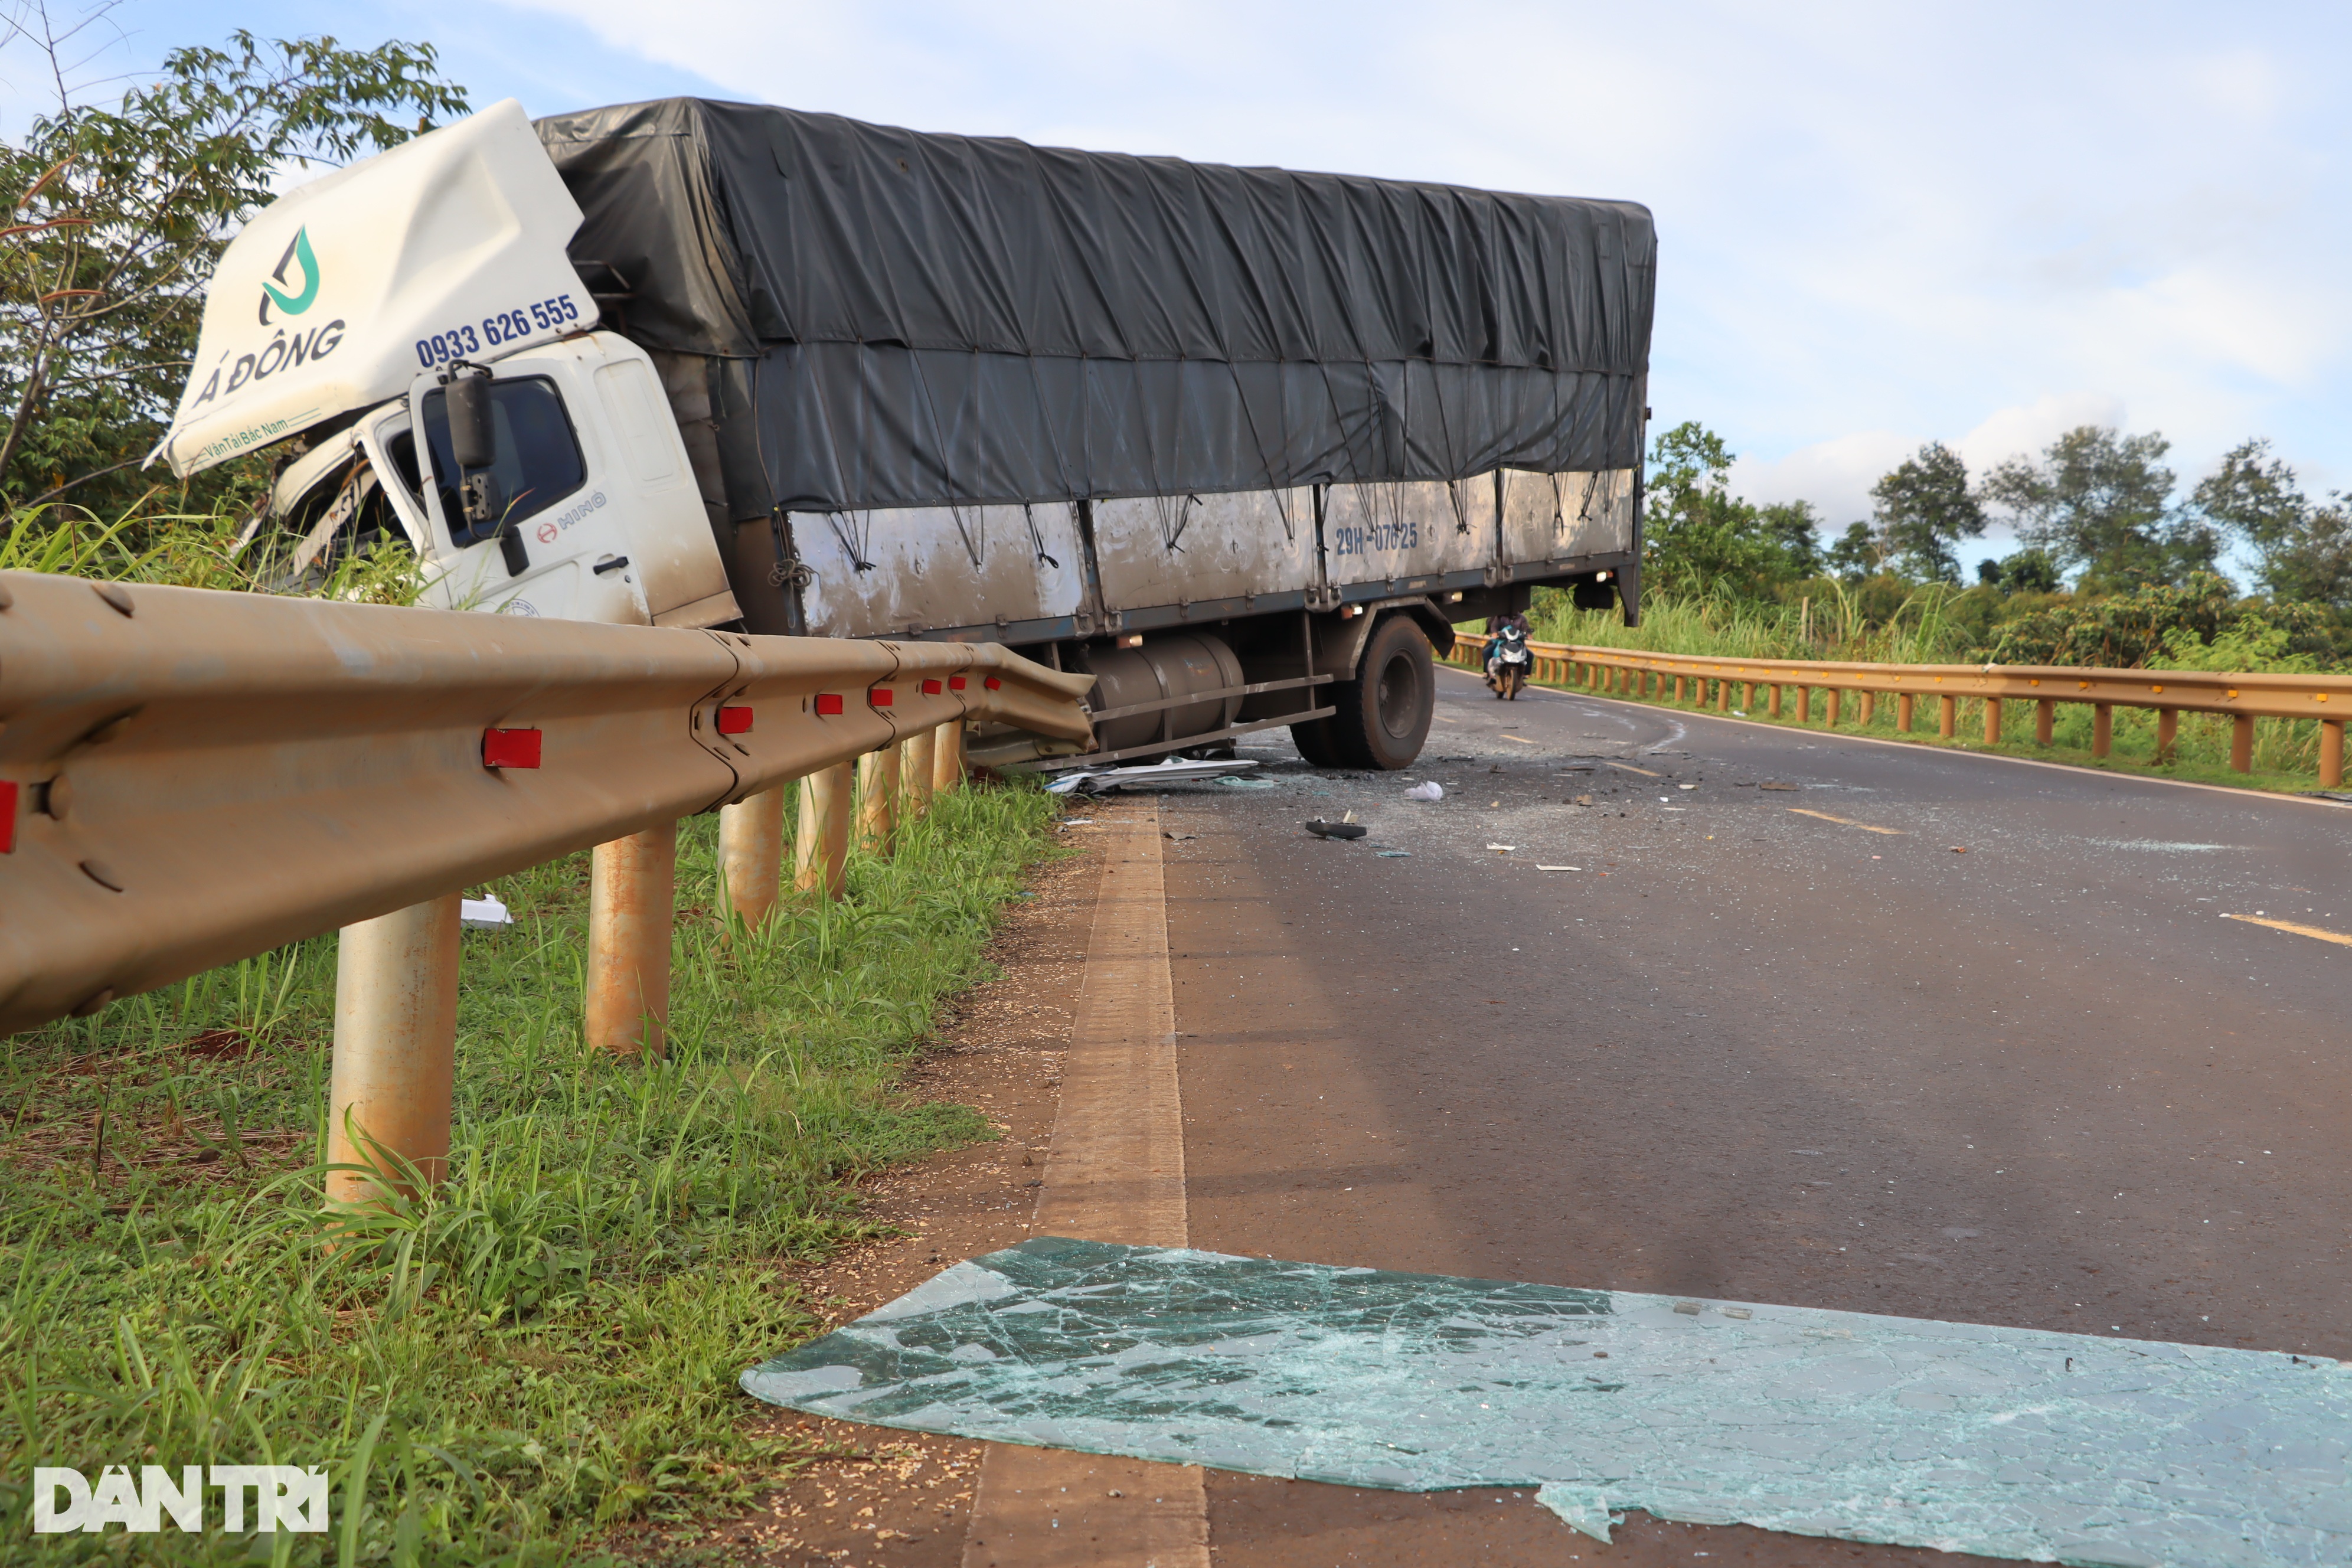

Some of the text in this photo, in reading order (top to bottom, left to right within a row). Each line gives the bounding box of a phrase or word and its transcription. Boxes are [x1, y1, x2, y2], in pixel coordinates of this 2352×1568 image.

[416, 293, 579, 368] 0933 626 555
[191, 319, 346, 409] Á ĐÔNG
[204, 419, 289, 459] Vận Tải Bắc Nam
[557, 492, 606, 530] HINO
